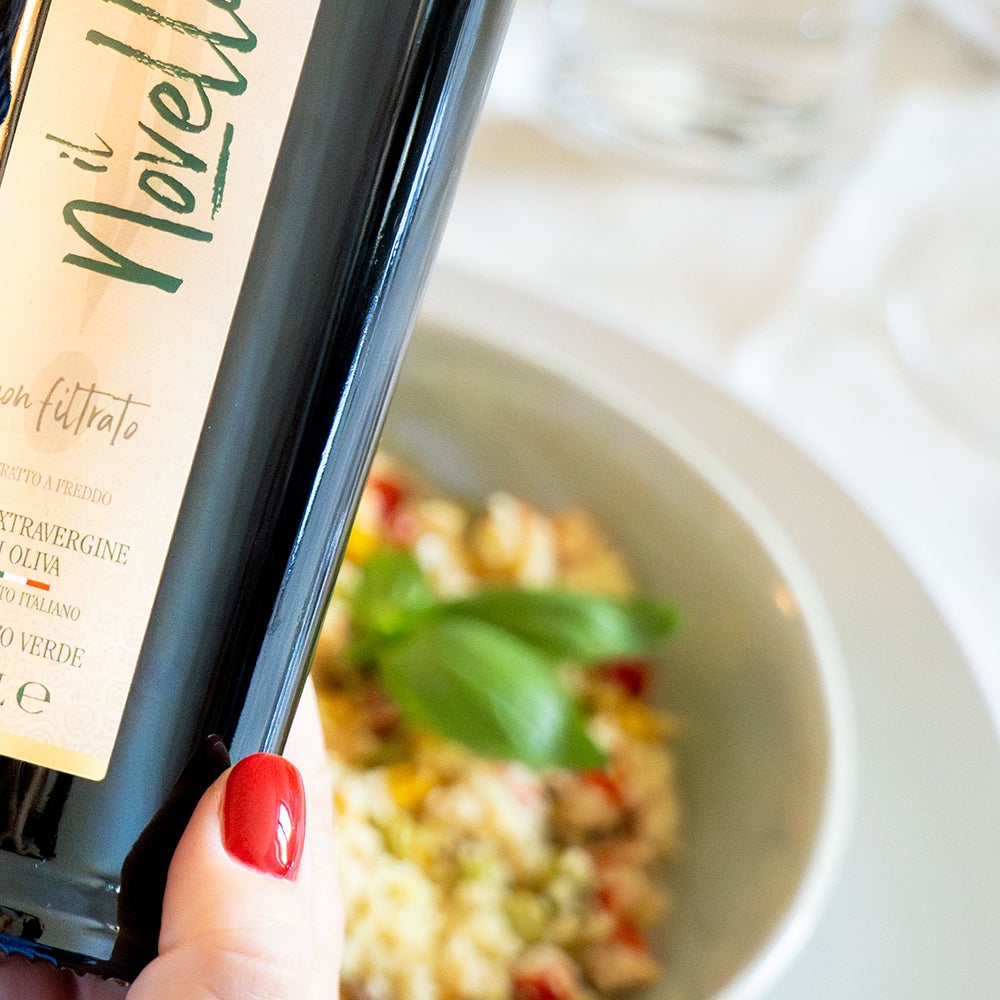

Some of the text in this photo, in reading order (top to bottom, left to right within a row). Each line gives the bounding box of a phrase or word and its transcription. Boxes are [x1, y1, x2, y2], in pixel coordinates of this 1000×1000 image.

[36, 376, 151, 446] filtrato
[43, 475, 53, 491] A
[55, 478, 113, 506] FREDDO
[8, 544, 61, 578] OLIVA
[17, 591, 82, 622] ITALIANO
[20, 631, 86, 668] VERDE
